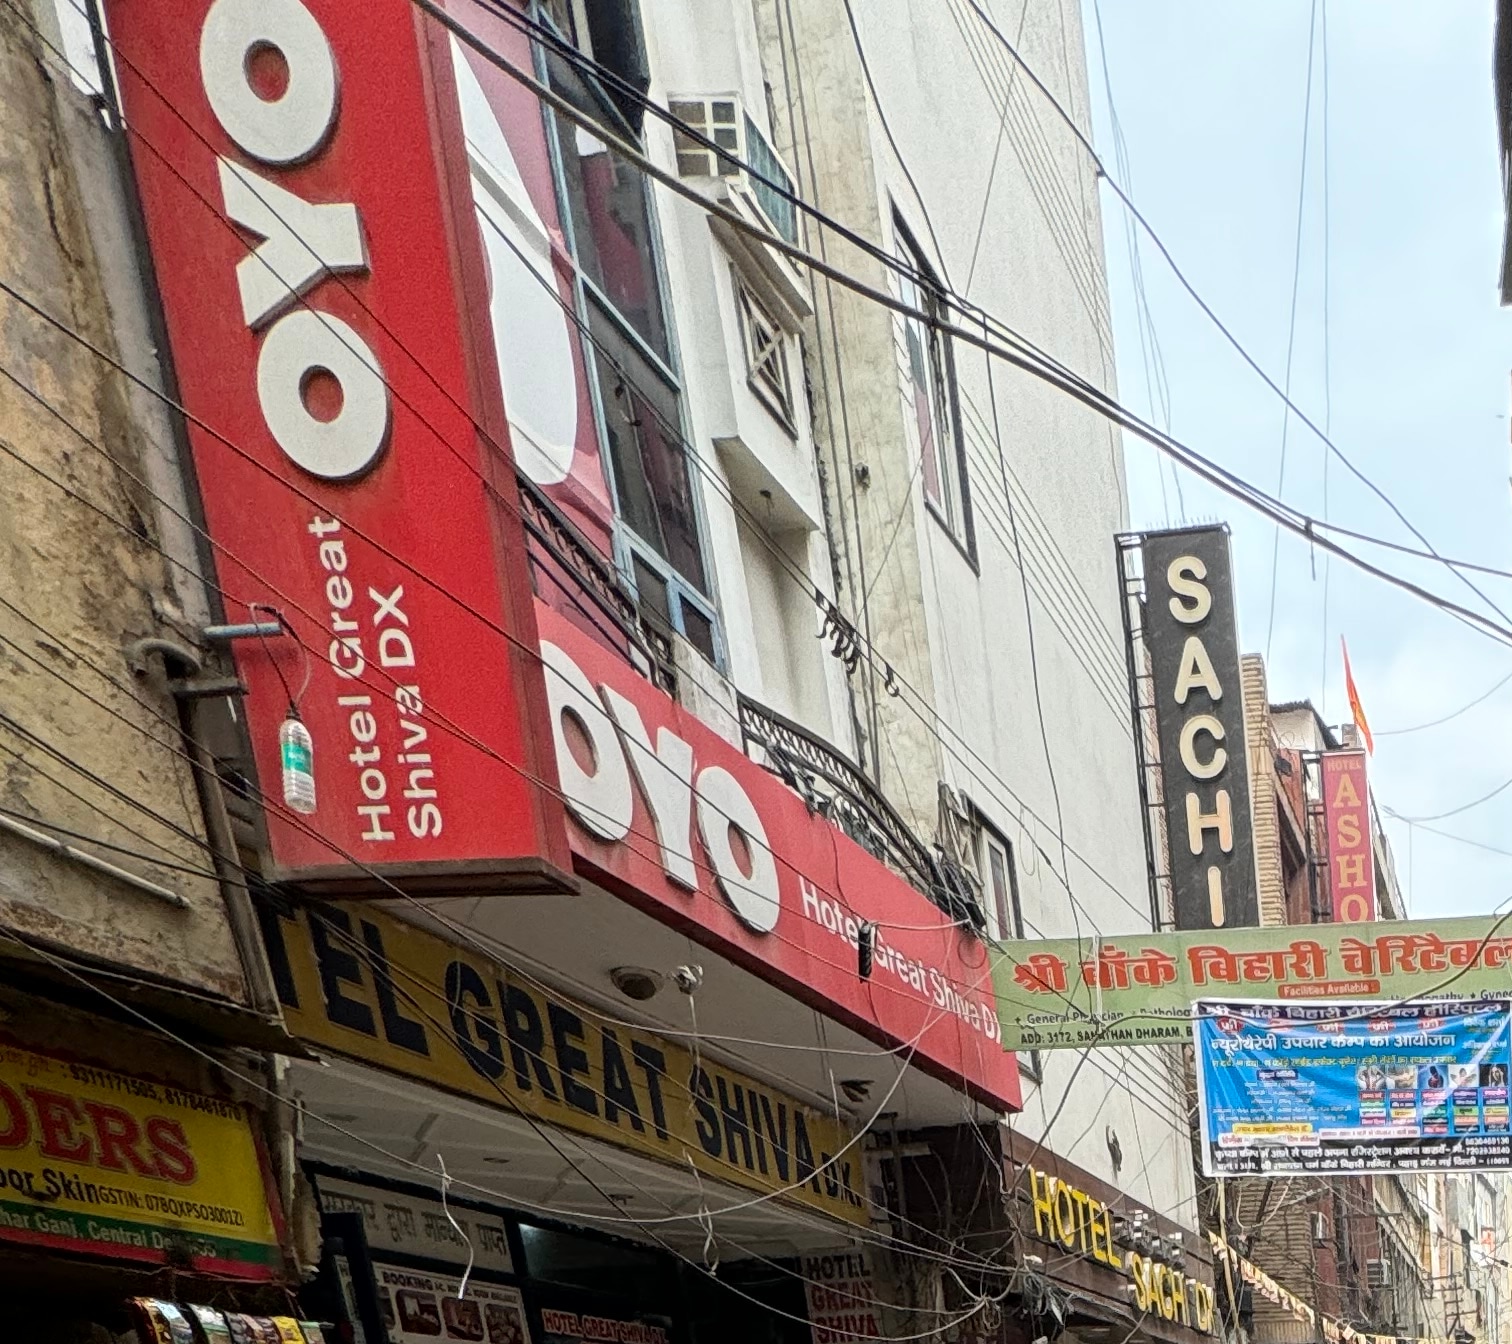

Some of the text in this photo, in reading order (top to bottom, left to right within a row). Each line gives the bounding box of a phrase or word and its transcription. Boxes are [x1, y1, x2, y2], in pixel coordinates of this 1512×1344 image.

[200, 0, 392, 482] OYO
[308, 516, 395, 843] Hotel Great
[368, 585, 443, 838] Shiva DX
[1166, 555, 1233, 928] SACHI
[1327, 758, 1362, 772] HOTEL
[540, 640, 780, 934] OYO
[801, 876, 862, 952] Hote
[929, 966, 982, 1032] Shiva
[1332, 774, 1369, 923] ASHO
[1013, 952, 1068, 994] श्री
[1187, 941, 1330, 987] बिहारी
[1284, 985, 1325, 997] Facilities
[1281, 1036, 1327, 1049] उपचार
[1394, 1032, 1456, 1048] आयोजन
[444, 960, 669, 1140] GREAT
[688, 1063, 822, 1195] SHIVA
[87, 1219, 148, 1248] Central
[1030, 1164, 1123, 1269] HOTEL
[1130, 1251, 1191, 1328] SACHI
[383, 1271, 434, 1291] BOOKING
[806, 1253, 871, 1280] HOTEL
[811, 1281, 873, 1312] GREAT
[541, 1308, 585, 1338] HOTEL
[582, 1314, 620, 1342] GREAT
[815, 1313, 880, 1344] SHIVA
